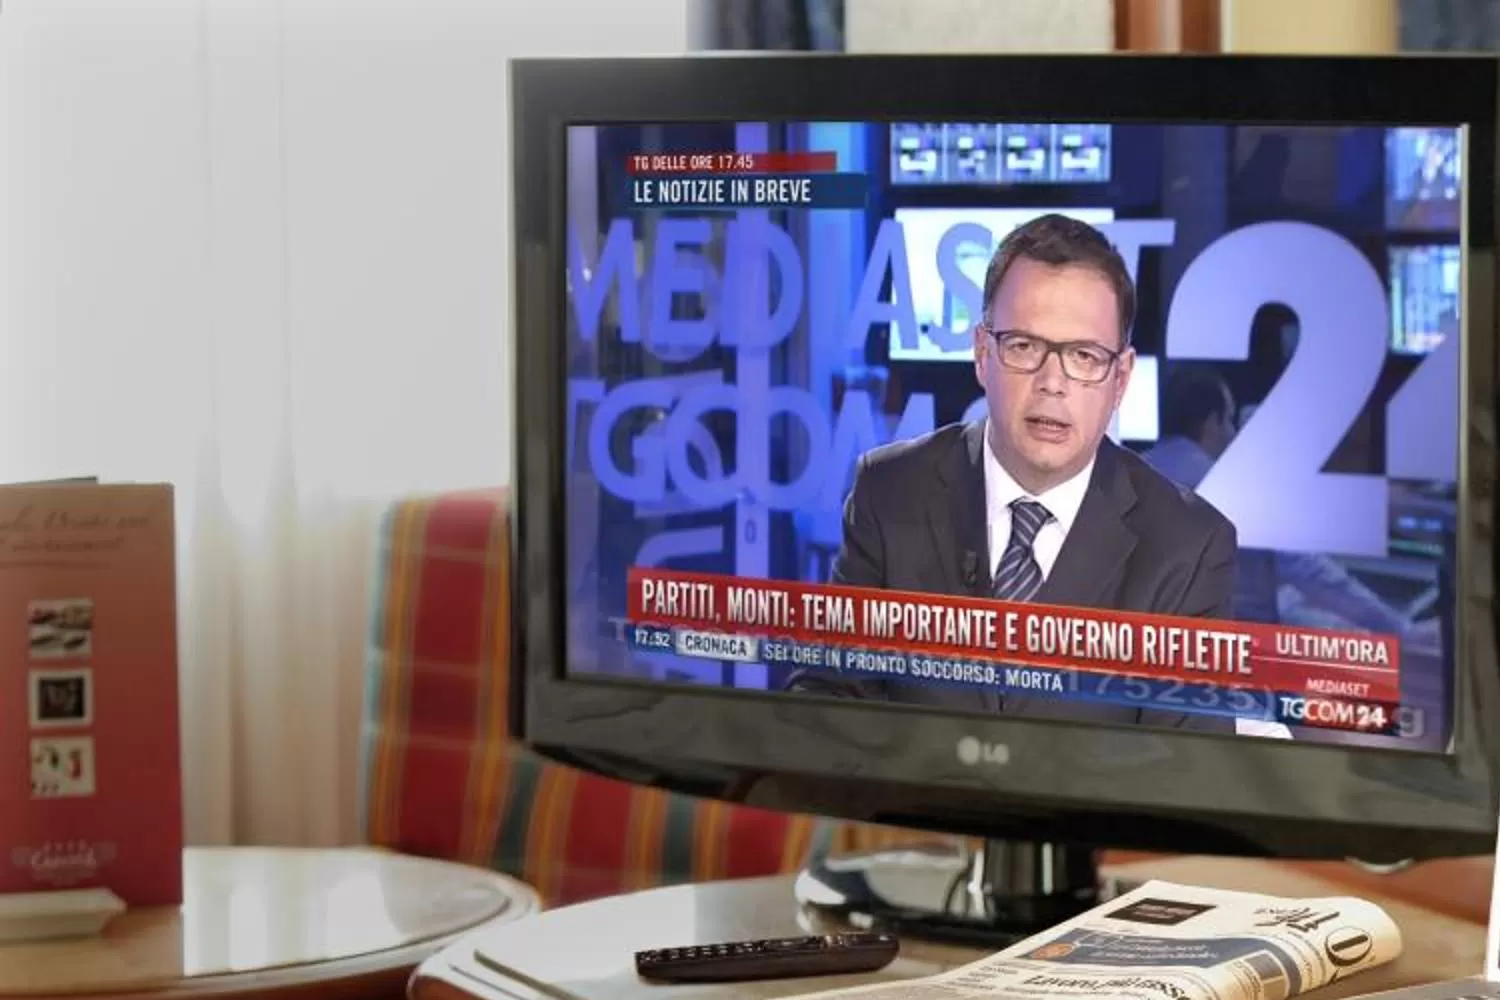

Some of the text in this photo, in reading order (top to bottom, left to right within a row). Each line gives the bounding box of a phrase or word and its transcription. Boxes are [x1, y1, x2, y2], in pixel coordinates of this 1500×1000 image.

[634, 154, 754, 170] TG DELLE ORE 17.45
[633, 179, 812, 203] LE NOTIZIE IN BREVE
[641, 577, 1253, 675] PARTITI, MONTI: TEMA IMPORTANTE E GOVERNO RIFLETTE
[684, 634, 748, 658] CRONACA
[1275, 630, 1390, 665] ULTIM'ORA
[762, 642, 1064, 693] SEI ORE IN PRONTO SOCCORSO: MORTA
[1306, 676, 1372, 697] MEDIASET
